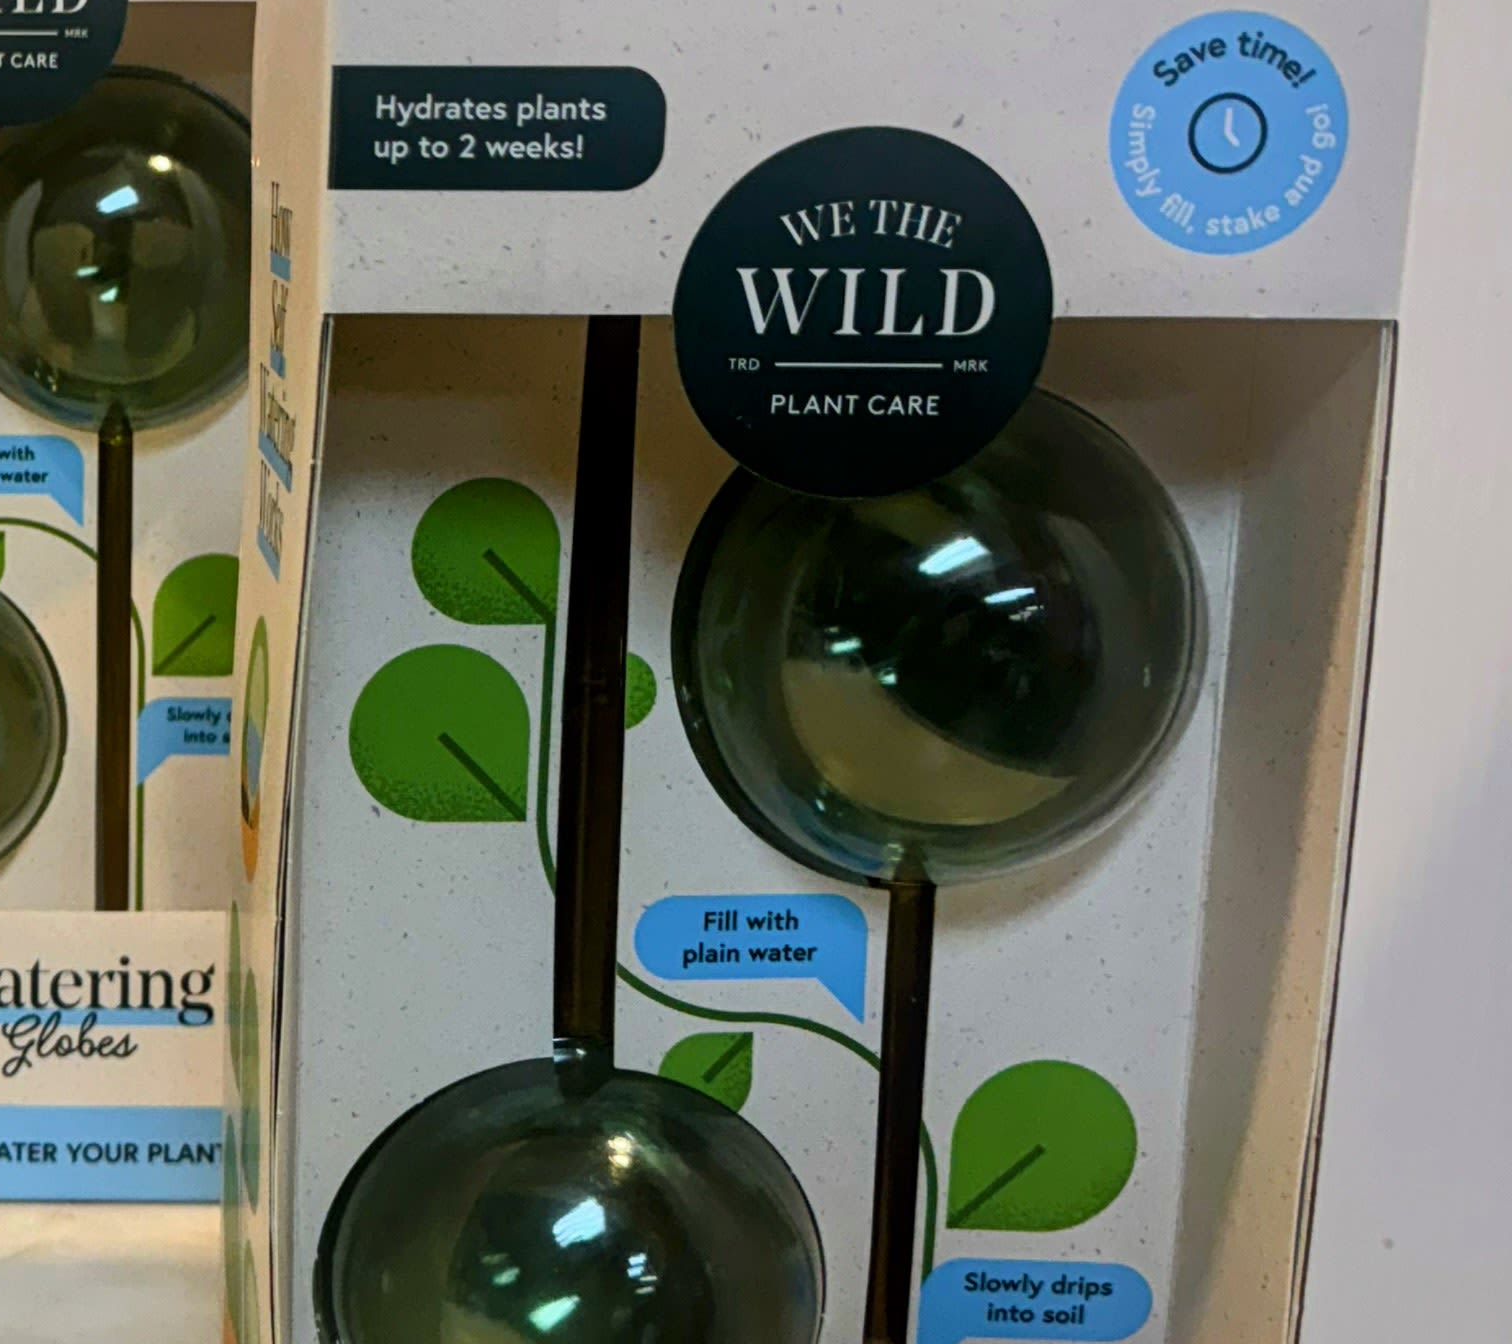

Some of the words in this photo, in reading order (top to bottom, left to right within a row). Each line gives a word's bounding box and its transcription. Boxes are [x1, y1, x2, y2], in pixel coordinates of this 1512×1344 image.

[11, 53, 58, 68] CARE
[1153, 37, 1227, 87] Save
[1238, 31, 1316, 88] time!
[375, 93, 506, 127] Hydrates
[516, 93, 606, 127] plants
[373, 138, 409, 164] up
[419, 135, 449, 159] to
[459, 133, 475, 159] 2
[485, 134, 583, 159] weeks!
[1125, 104, 1161, 197] Simply
[1160, 193, 1196, 233] fill,
[1205, 205, 1280, 235] stake
[1284, 155, 1322, 206] and
[1305, 104, 1336, 149] go!
[780, 201, 855, 246] WE
[869, 199, 962, 248] THE
[736, 267, 995, 335] WILD
[729, 358, 760, 370] TRD
[953, 360, 988, 372] MRK
[771, 394, 859, 414] PLANT
[868, 395, 940, 415] CARE
[0, 469, 48, 484] water
[167, 706, 221, 726] Slowly
[184, 728, 217, 743] into
[703, 912, 738, 932] Fill
[745, 910, 799, 931] with
[682, 943, 741, 968] plain
[749, 943, 816, 963] water
[1, 1012, 138, 1077] Globes
[66, 1142, 138, 1165] YOUR
[147, 1143, 222, 1165] PLAN
[963, 1271, 1043, 1298] Slowly
[1051, 1275, 1113, 1302] drips
[987, 1303, 1035, 1324] into
[1042, 1304, 1085, 1325] soil
